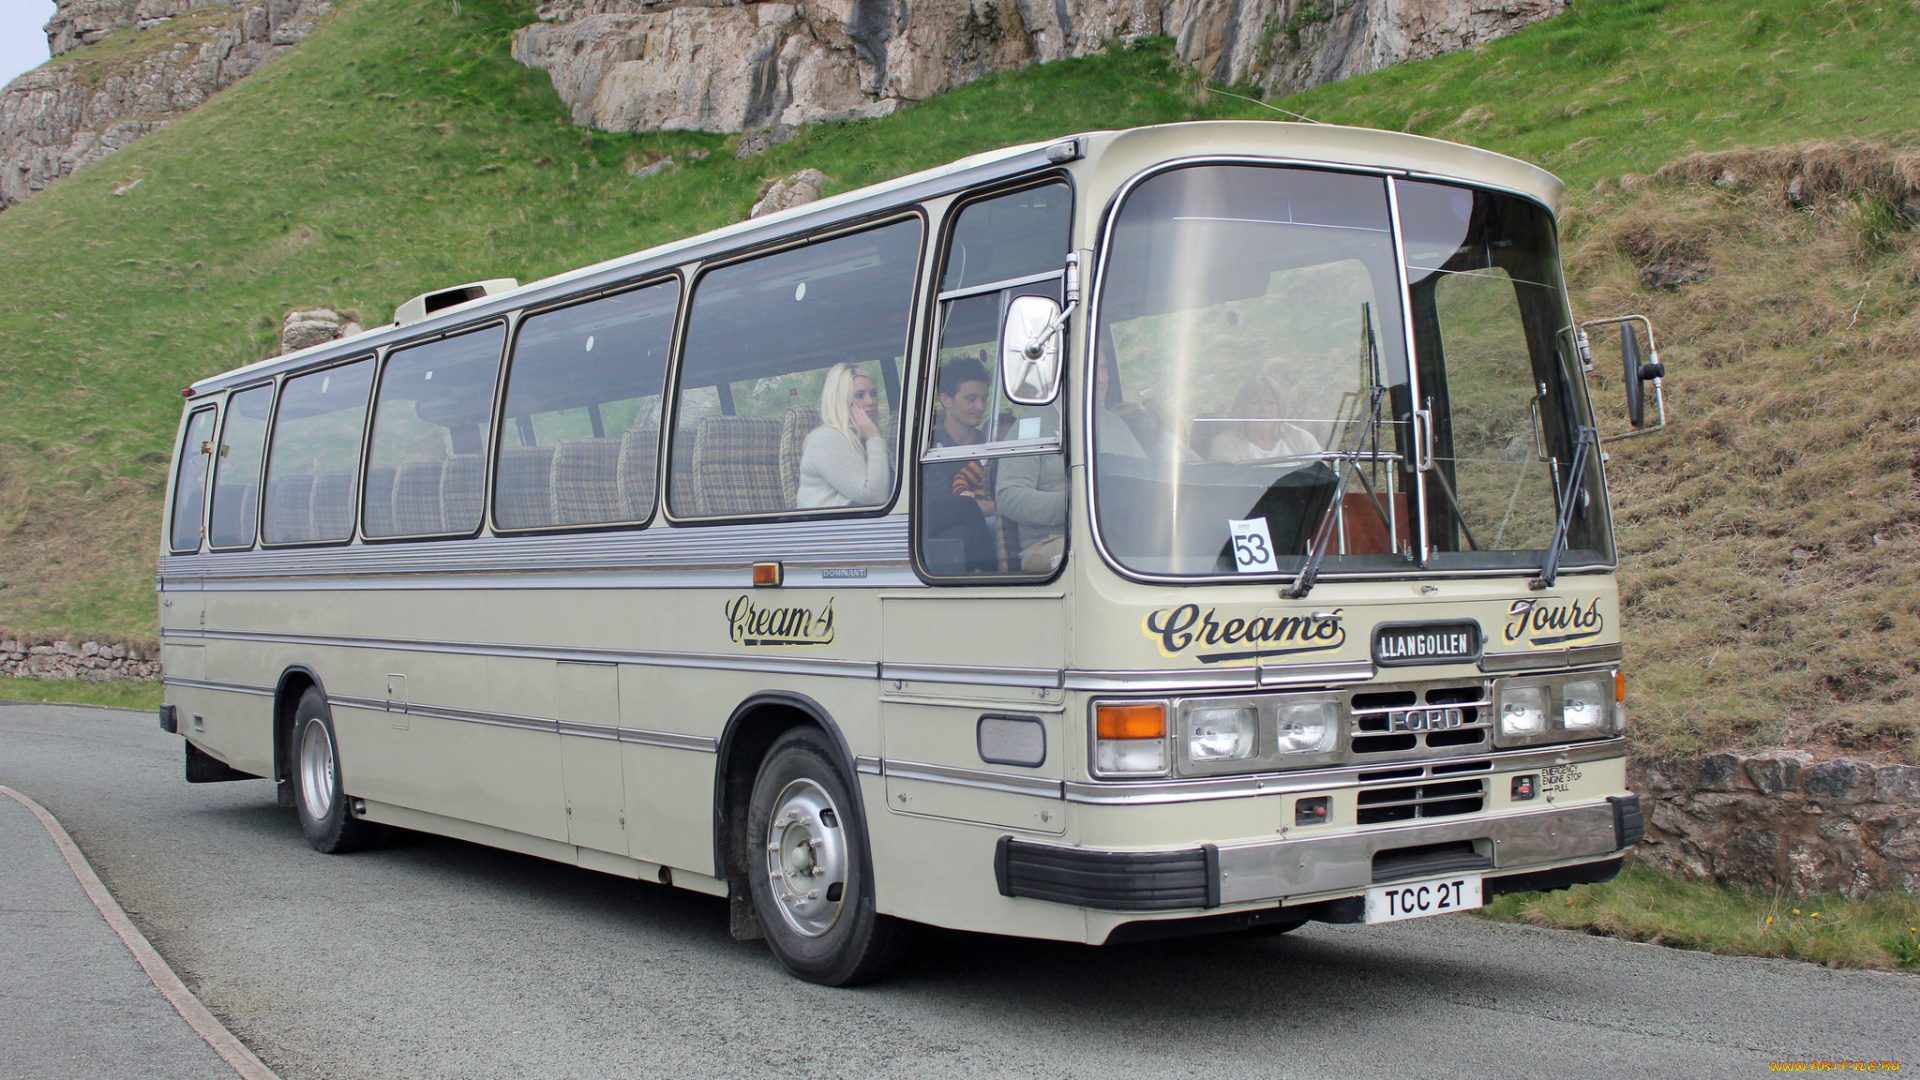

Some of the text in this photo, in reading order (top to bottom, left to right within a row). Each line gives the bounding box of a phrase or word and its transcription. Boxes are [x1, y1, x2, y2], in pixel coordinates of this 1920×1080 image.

[1234, 533, 1270, 566] 53
[823, 569, 866, 578] DOMINANT
[1145, 597, 1602, 652] Creams Tours
[1381, 633, 1467, 657] LLANGOLLEN
[1388, 708, 1464, 733] FORD
[1541, 764, 1579, 777] EMERGENCY
[1542, 772, 1582, 786] ENGINE STOP
[1554, 783, 1569, 792] PULL
[1385, 880, 1464, 916] TCC 2T
